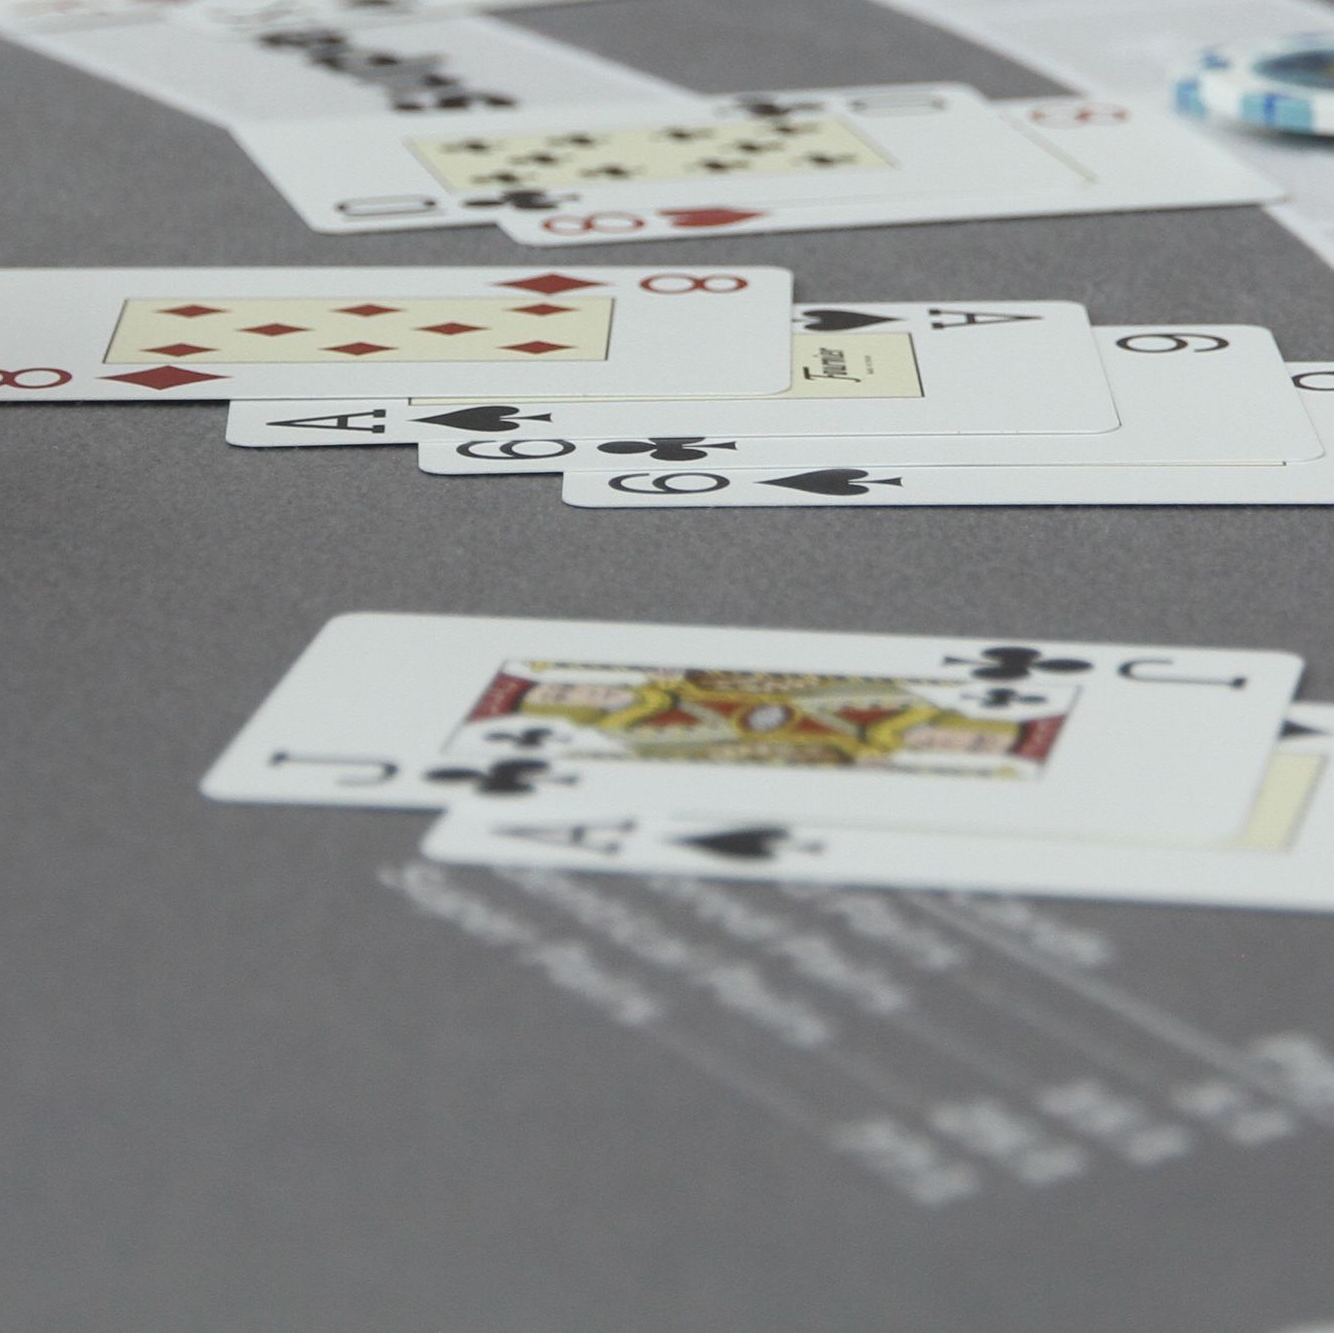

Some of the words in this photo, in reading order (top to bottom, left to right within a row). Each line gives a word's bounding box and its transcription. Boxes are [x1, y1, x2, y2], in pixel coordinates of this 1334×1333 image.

[542, 212, 646, 235] 8
[639, 272, 748, 295] 8
[928, 309, 1043, 329] A
[1116, 333, 1229, 353] 6
[266, 409, 387, 434] A
[456, 439, 576, 459] 6
[608, 472, 730, 495] 6
[1117, 658, 1248, 689] J
[269, 750, 398, 786] J
[493, 819, 637, 856] A
